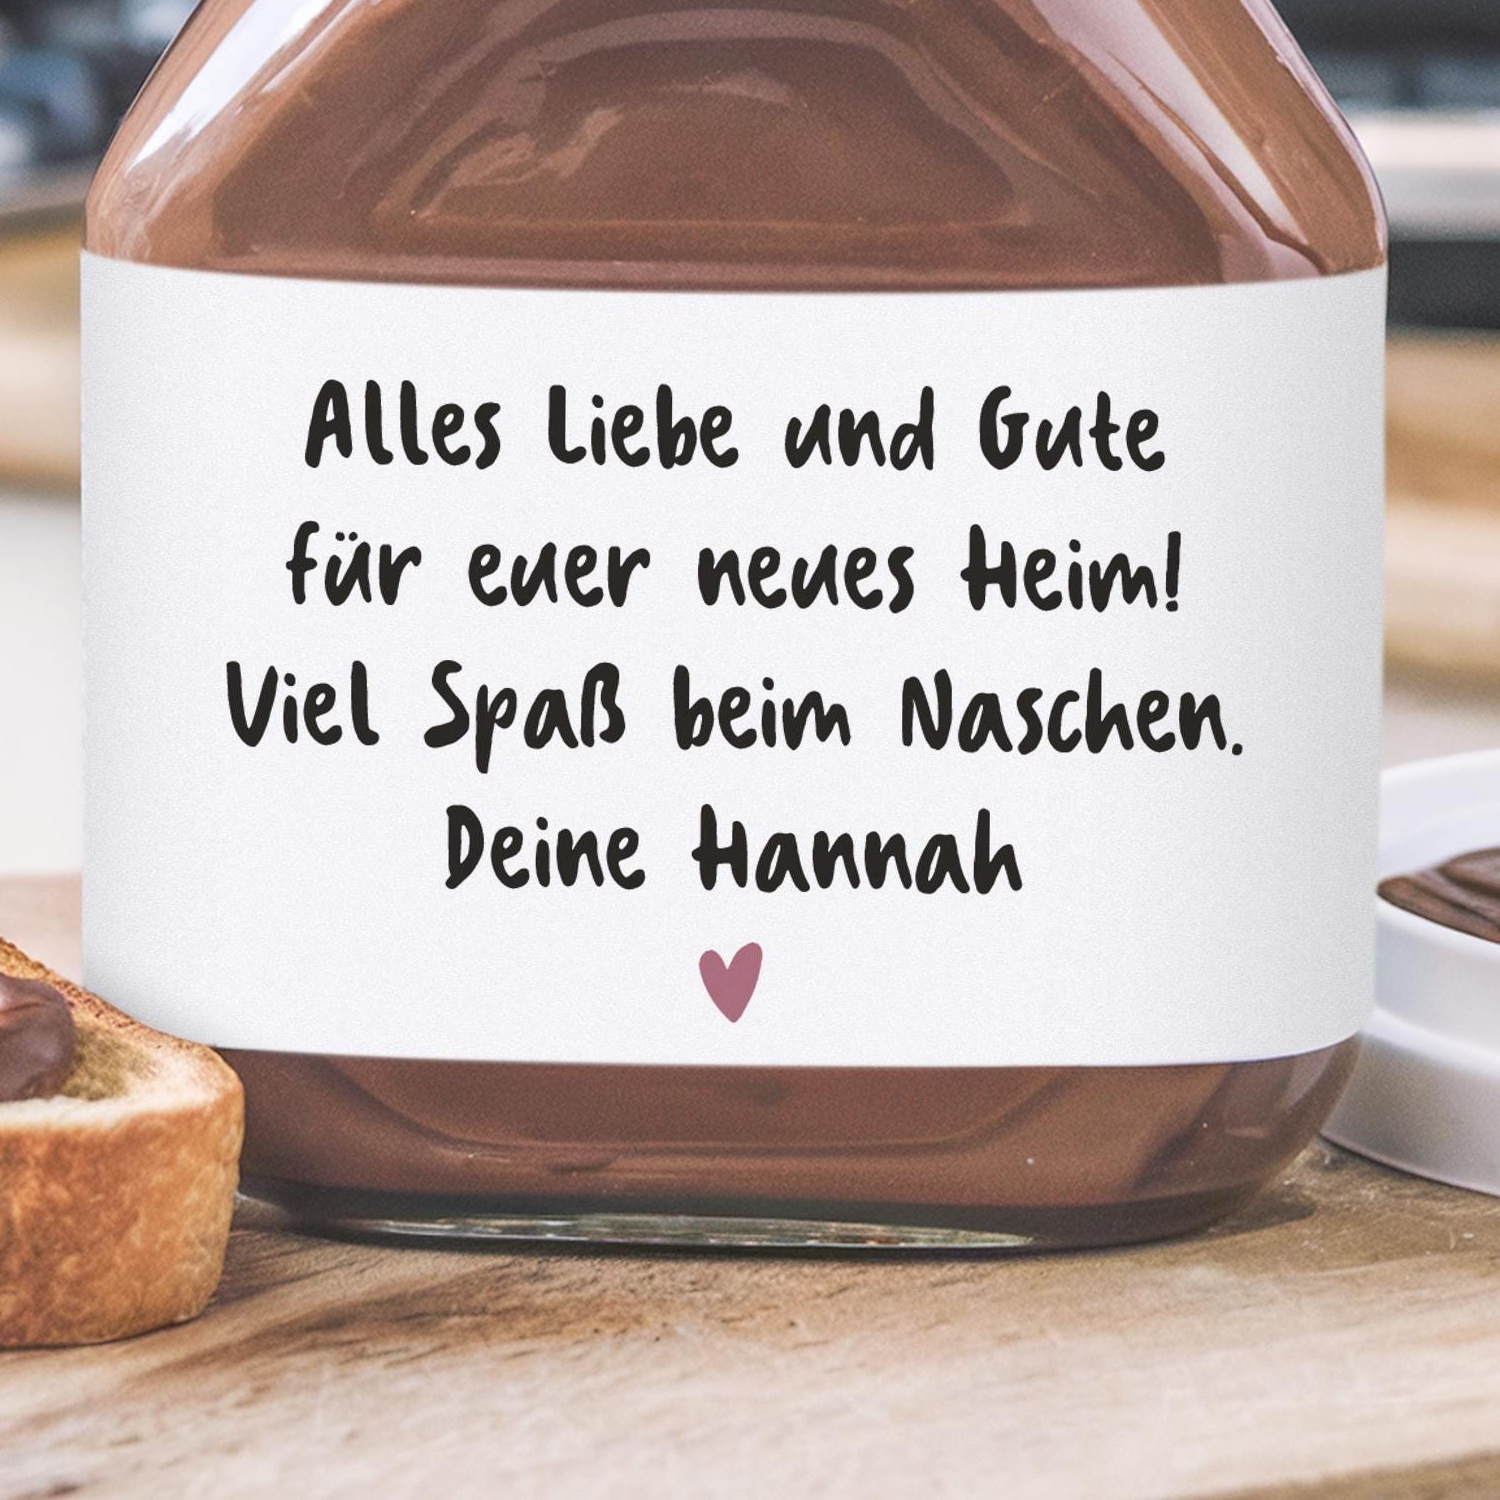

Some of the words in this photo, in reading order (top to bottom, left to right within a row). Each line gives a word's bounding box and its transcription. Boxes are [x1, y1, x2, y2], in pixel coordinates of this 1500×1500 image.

[305, 380, 500, 469] Alles
[548, 384, 738, 469] Liebe
[785, 386, 934, 470] und
[980, 386, 1165, 472] Gute
[286, 521, 421, 606] für
[468, 542, 650, 607] euer
[698, 545, 914, 613] neues
[961, 524, 1181, 612] Heim!
[227, 661, 379, 747] Viel
[424, 660, 625, 774] Spaß
[673, 665, 851, 750] beim
[902, 668, 1242, 755] Naschen.
[445, 805, 645, 890] Deine
[692, 804, 1022, 894] Hannah
